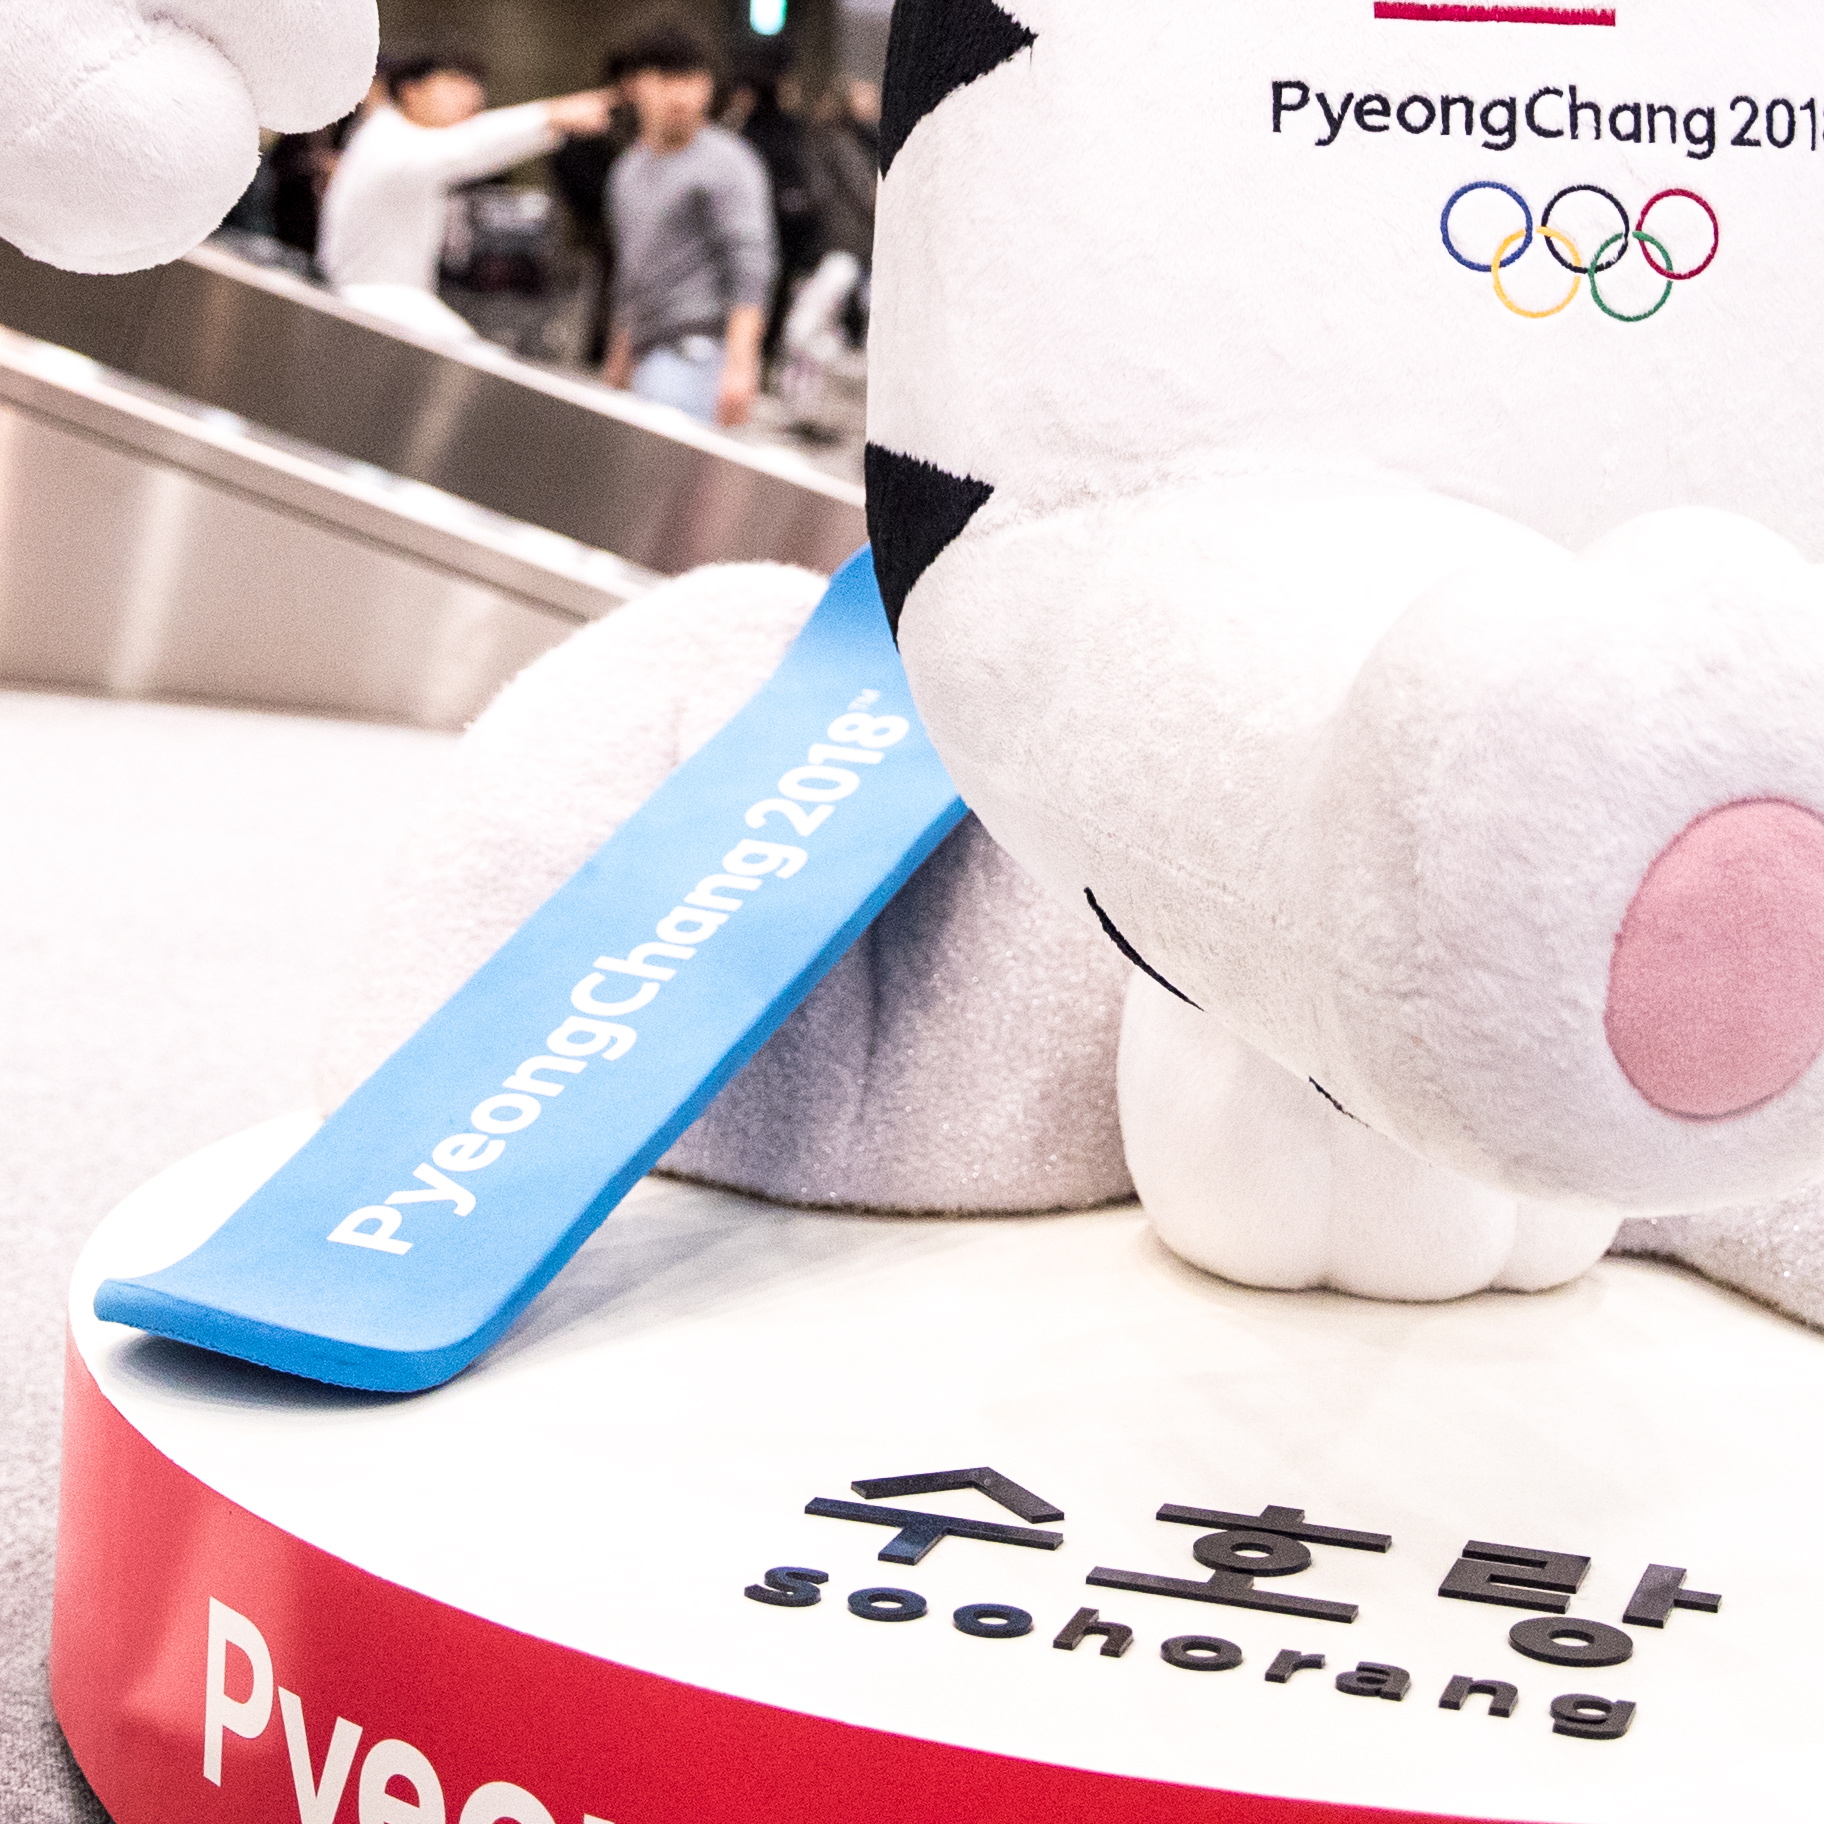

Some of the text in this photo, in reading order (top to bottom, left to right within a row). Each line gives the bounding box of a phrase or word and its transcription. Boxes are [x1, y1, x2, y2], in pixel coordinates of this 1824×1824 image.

[1271, 79, 1716, 159] PyeongChang
[327, 838, 808, 1256] PyeongChang
[743, 1565, 1638, 1741] soohorang
[803, 1466, 1723, 1668] 수호랑
